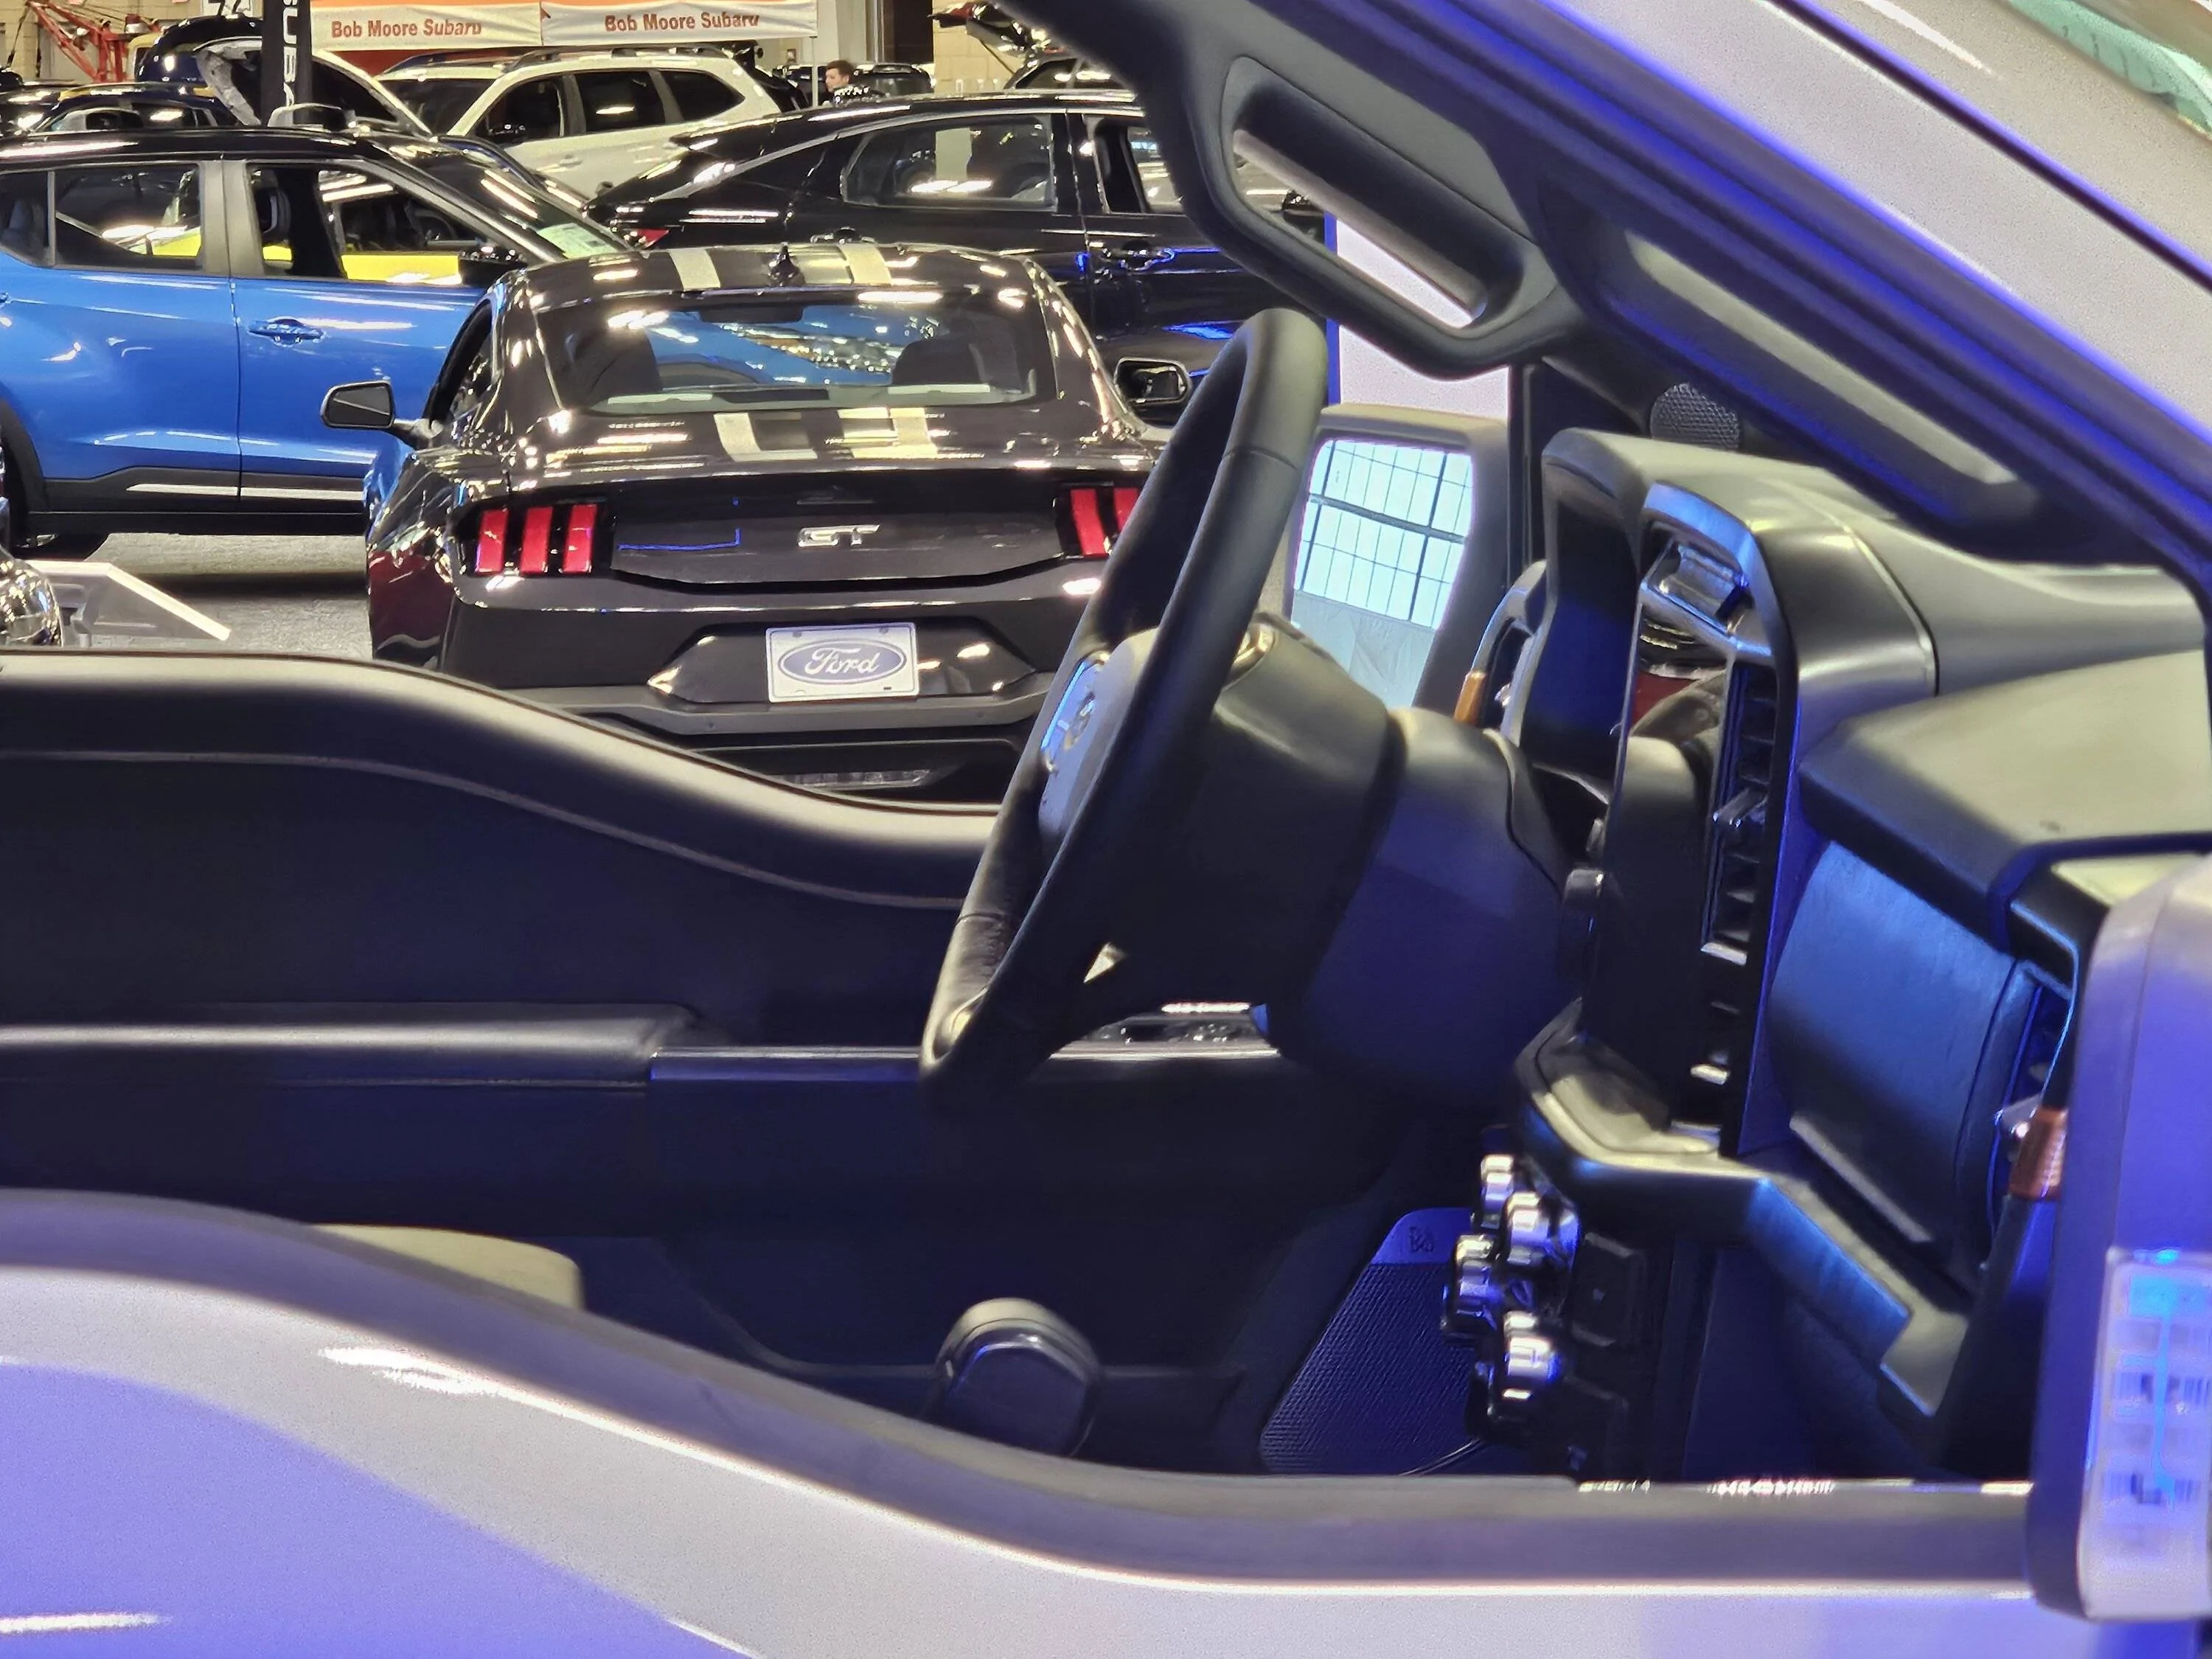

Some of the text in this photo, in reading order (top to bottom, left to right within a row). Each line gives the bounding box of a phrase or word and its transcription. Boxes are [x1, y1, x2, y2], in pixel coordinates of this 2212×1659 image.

[331, 18, 482, 38] Bob Moore Subaru
[605, 12, 760, 32] Bob Moore Subaru
[283, 0, 298, 107] UBA
[798, 524, 880, 546] GT
[804, 647, 880, 675] Ford
